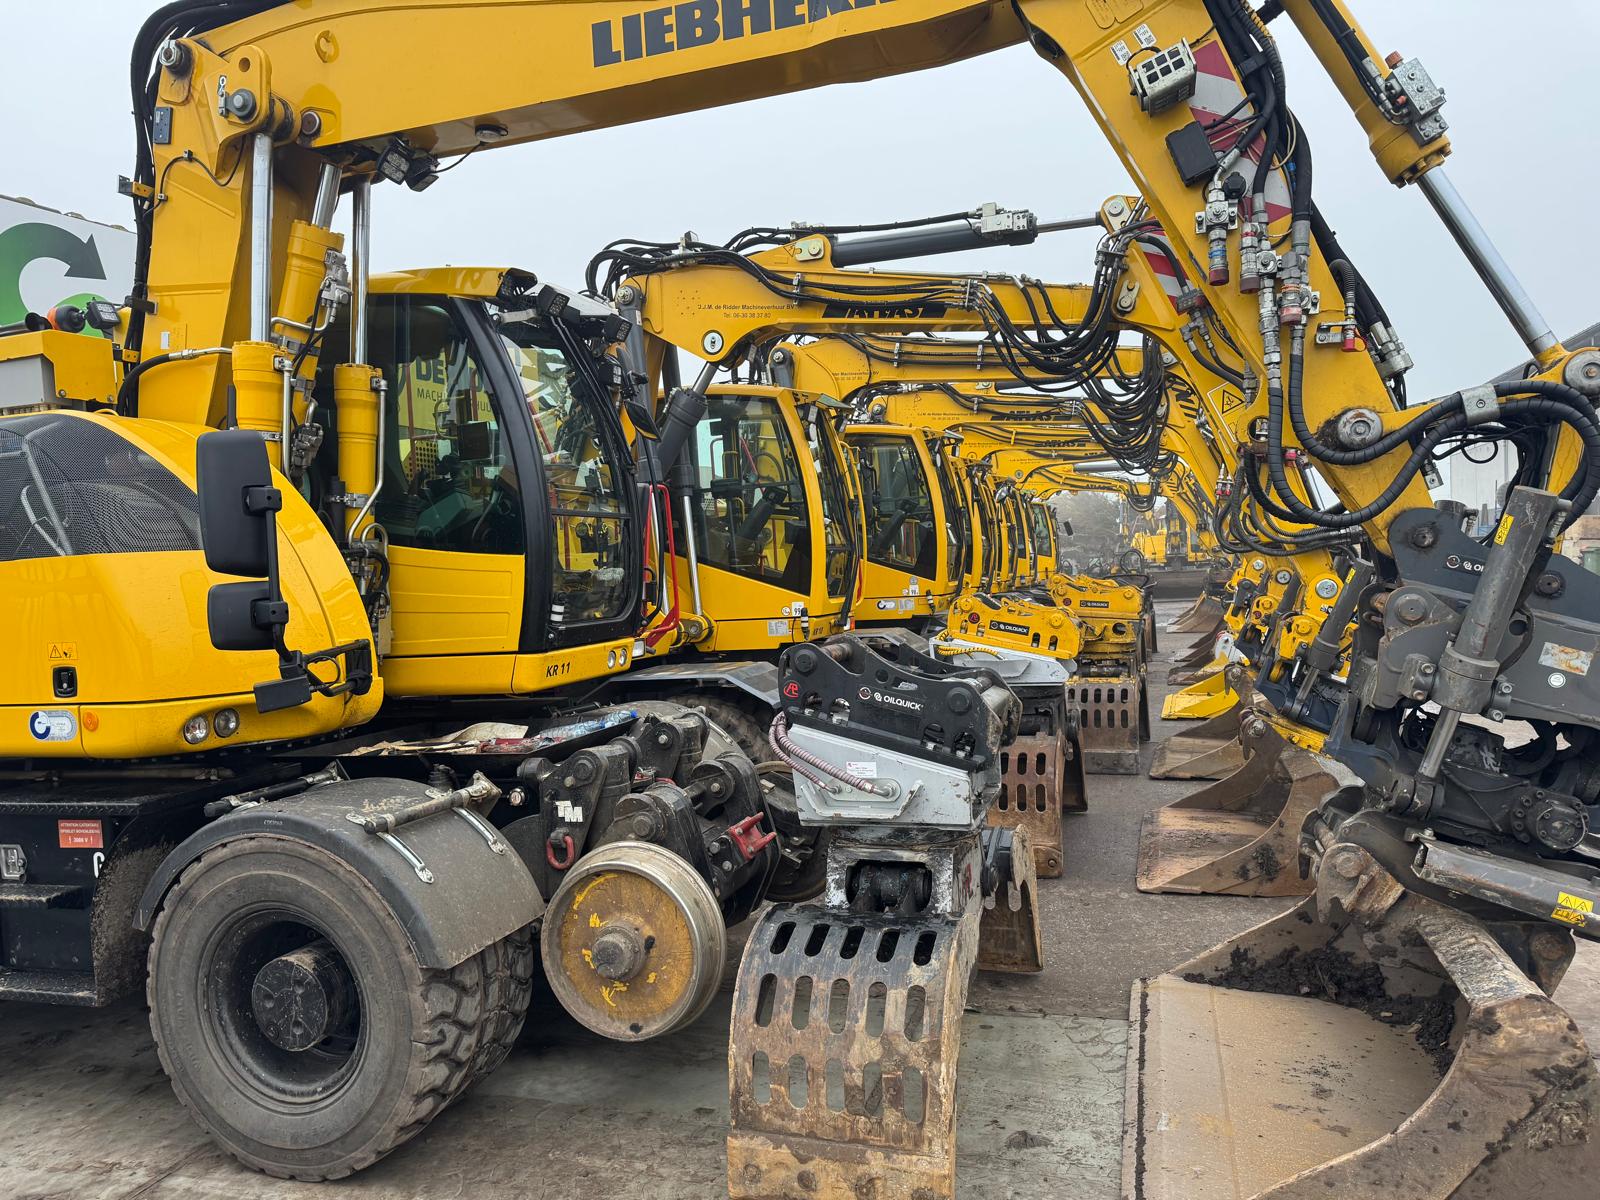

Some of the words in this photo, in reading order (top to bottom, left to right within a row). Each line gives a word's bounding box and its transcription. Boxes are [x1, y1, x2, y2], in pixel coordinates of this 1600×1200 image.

[591, 0, 897, 68] LIEBHE
[1005, 625, 1028, 633] OILQUICK
[546, 664, 559, 678] KR
[561, 662, 571, 675] 11
[883, 695, 922, 711] OILQUICK
